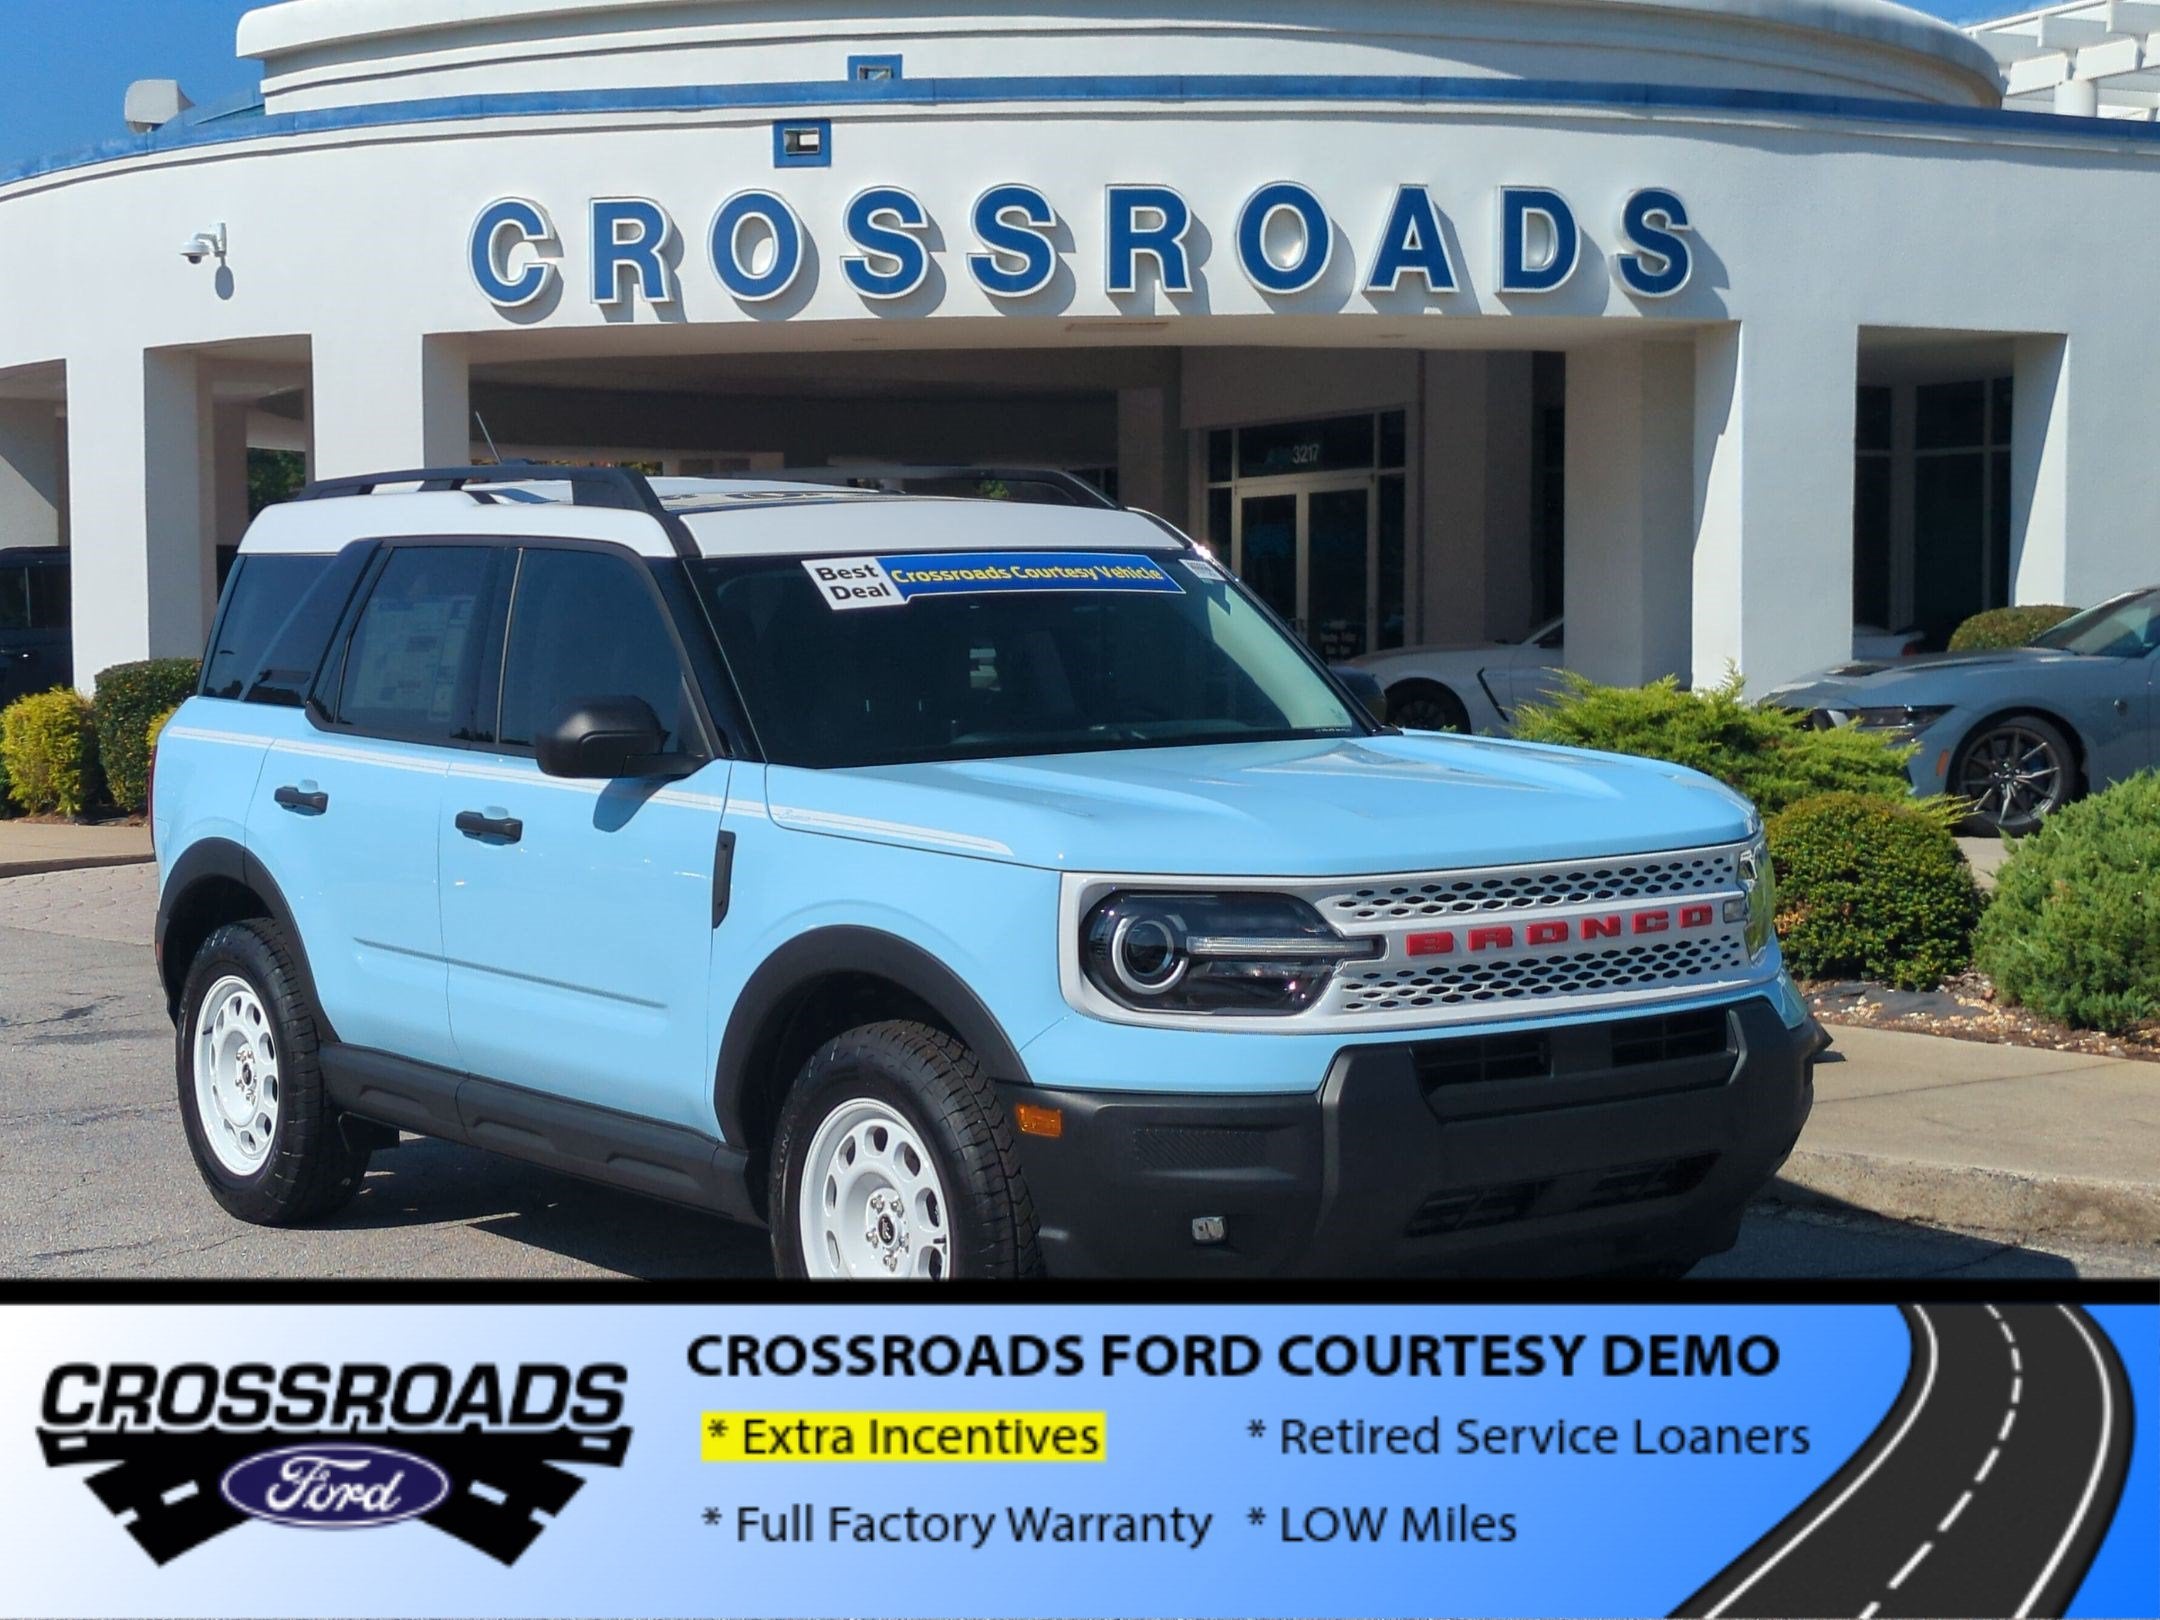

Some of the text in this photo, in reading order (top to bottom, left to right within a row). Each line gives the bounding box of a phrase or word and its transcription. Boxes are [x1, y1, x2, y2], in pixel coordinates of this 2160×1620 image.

[467, 182, 1693, 303] CROSSROADS
[1292, 443, 1320, 464] 3217
[815, 564, 879, 581] Best
[891, 565, 1165, 584] Crossroads Courtesy Vehicle
[829, 582, 891, 600] Deal
[1406, 903, 1713, 957] BRONCO
